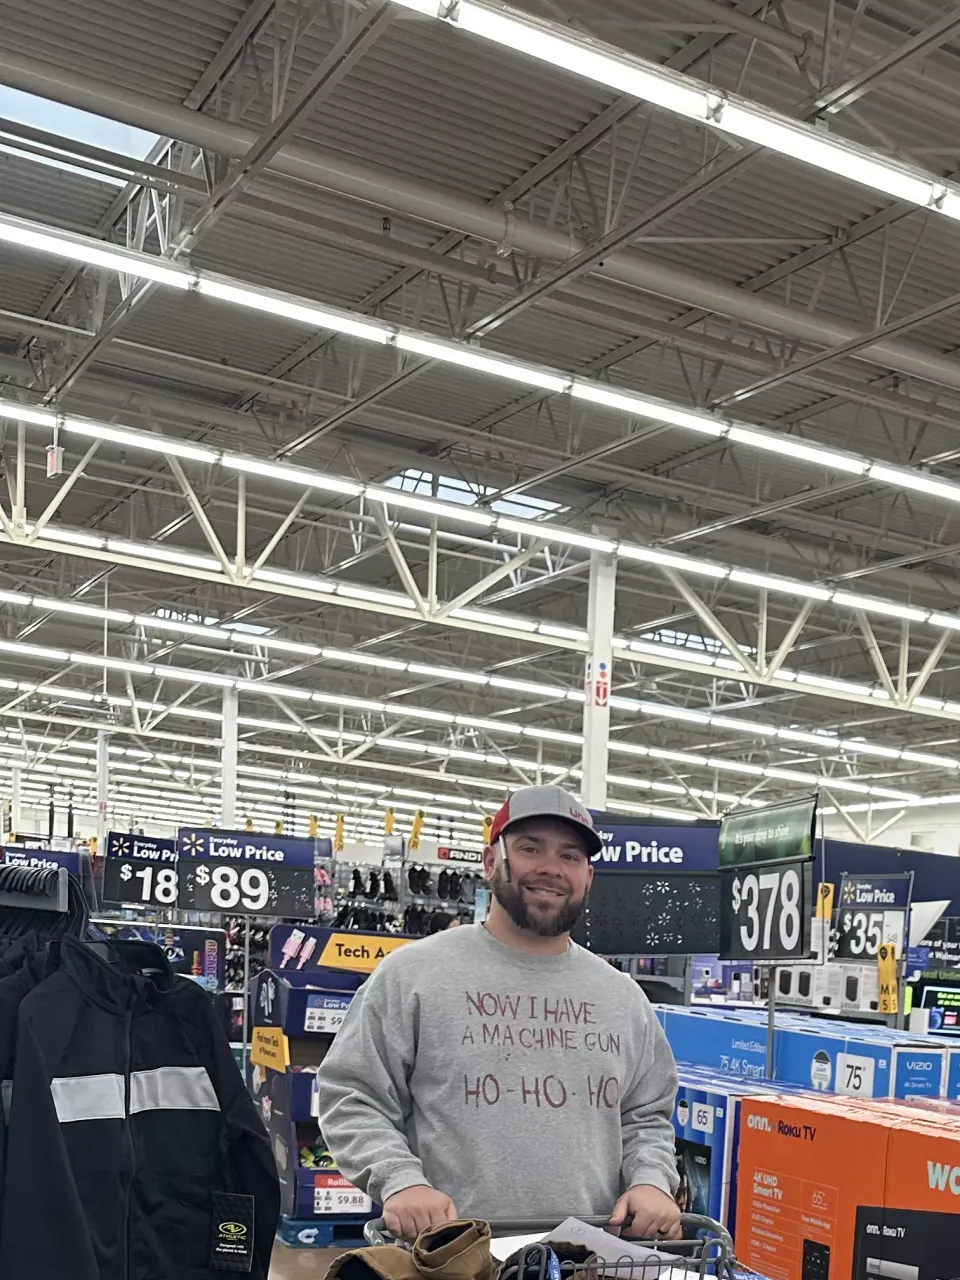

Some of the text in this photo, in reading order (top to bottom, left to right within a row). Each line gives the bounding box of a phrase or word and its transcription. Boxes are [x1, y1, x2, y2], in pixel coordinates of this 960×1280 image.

[133, 845, 160, 859] Low
[209, 842, 285, 862] Low Price
[625, 841, 684, 864] Price
[5, 856, 59, 871] Low Price
[195, 864, 270, 910] $89
[856, 889, 896, 903] Low Price
[731, 868, 801, 952] $378
[843, 912, 884, 955] $35
[335, 943, 370, 959] Tech
[920, 939, 933, 947] ore
[942, 941, 958, 950] your
[881, 983, 890, 995] M
[465, 991, 597, 1025] NOW I HAVE
[461, 1023, 621, 1056] A MACHINE GUN
[731, 1038, 750, 1052] Limited
[742, 1061, 765, 1079] Smart
[906, 1061, 933, 1071] VIZIO
[747, 1114, 817, 1142] onn. Roku TV
[753, 1183, 783, 1200] Smart TV
[337, 1195, 365, 1206] $9.88
[866, 1224, 906, 1238] onn. Roku TV
